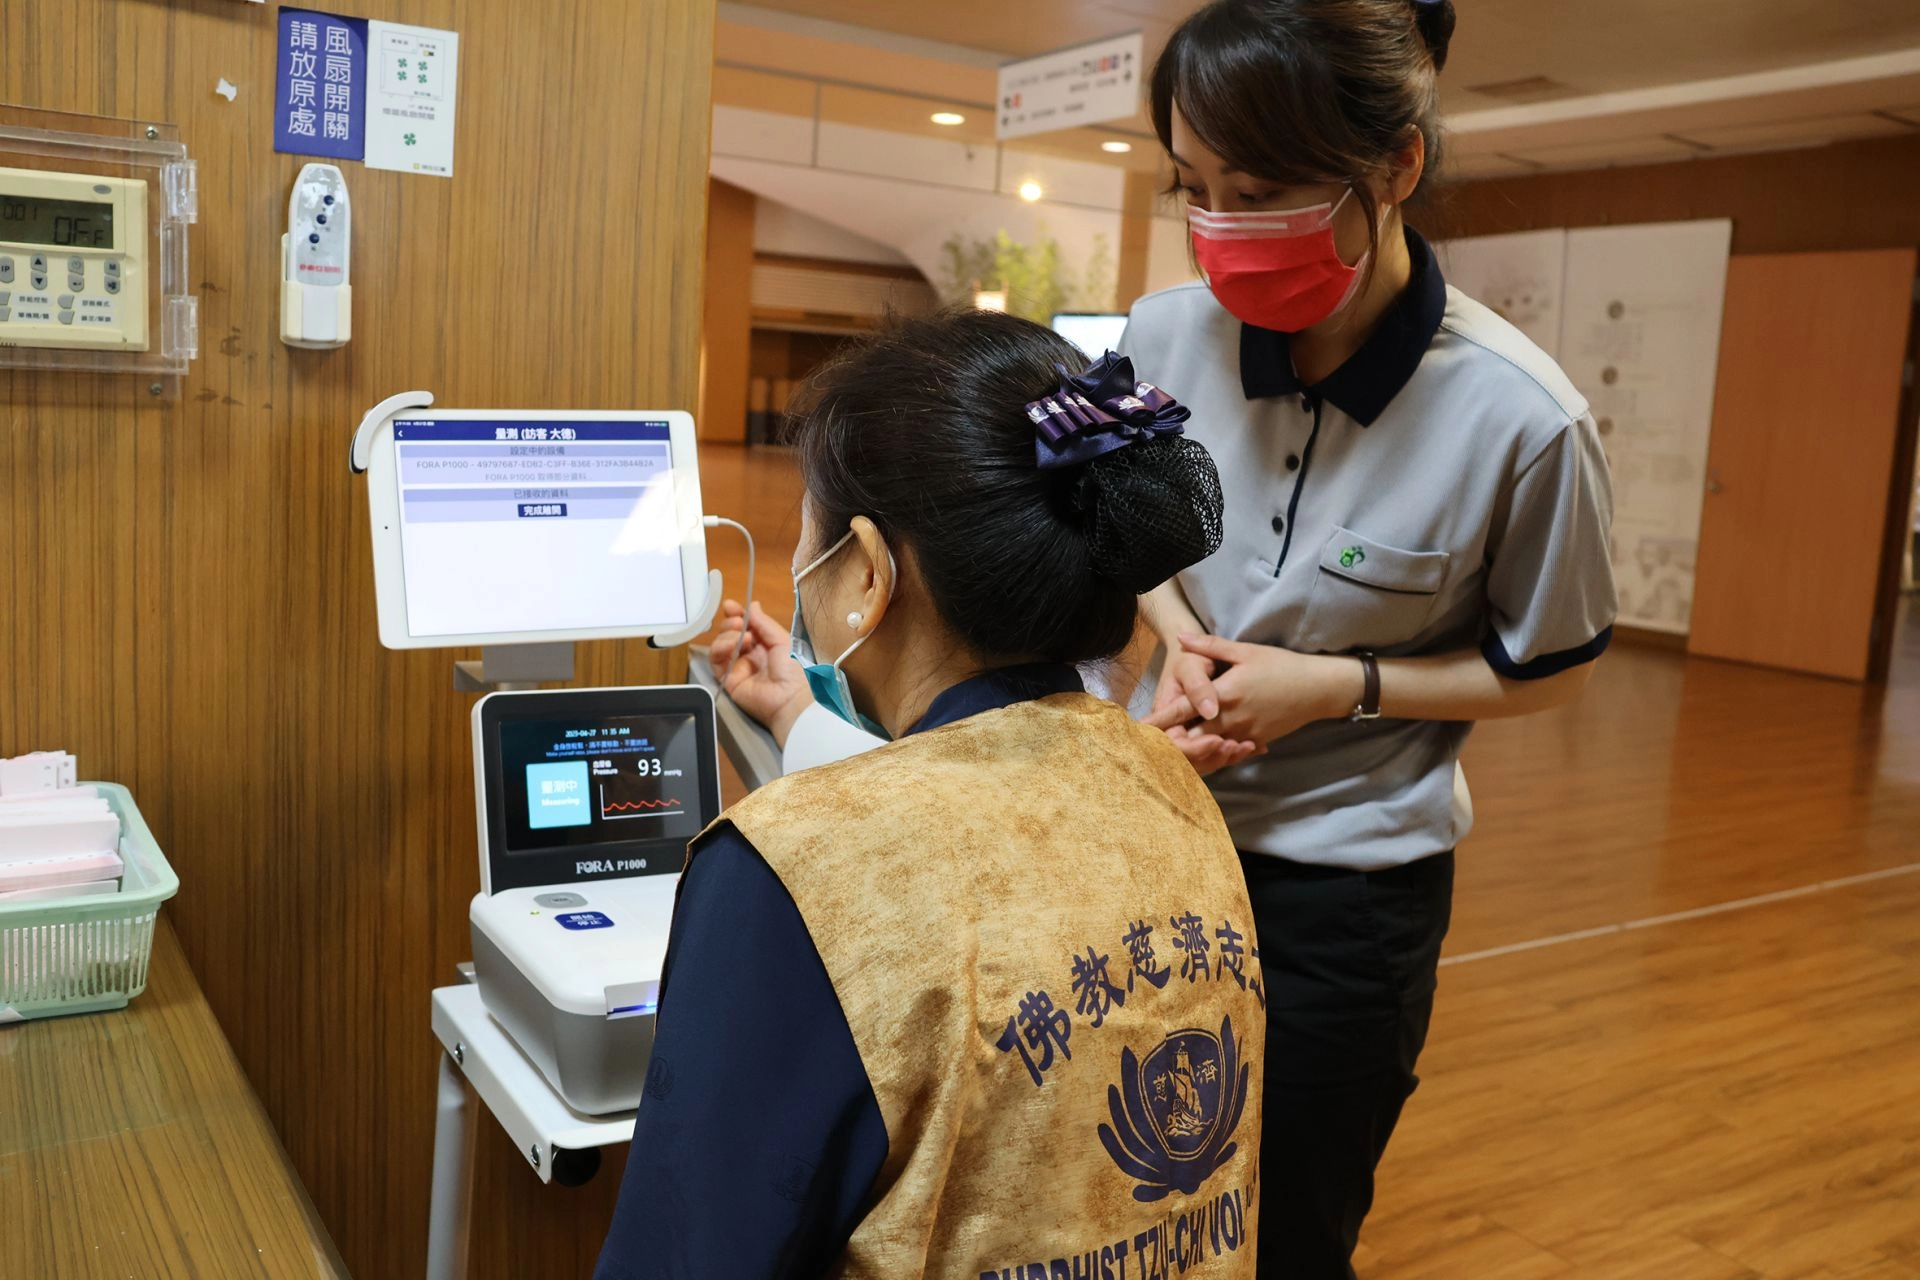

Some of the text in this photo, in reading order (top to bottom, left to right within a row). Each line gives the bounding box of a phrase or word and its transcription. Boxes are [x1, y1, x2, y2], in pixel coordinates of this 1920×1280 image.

[288, 20, 317, 136] 請放原處
[323, 26, 352, 140] 風扇開關
[495, 427, 576, 440] 量測 (訪客 大德)
[510, 446, 565, 456] 設定中的設備
[416, 461, 442, 469] FORA
[443, 460, 468, 468] P1000
[485, 473, 508, 481] FORA
[510, 473, 535, 481] P1000
[514, 488, 568, 499] 已接收的資料
[619, 727, 630, 735] AM
[638, 758, 661, 776] 93
[541, 779, 578, 794] 量測中
[576, 858, 647, 874] FORA P1000
[979, 1185, 1251, 1280] DHIST TZU-CHI VOL
